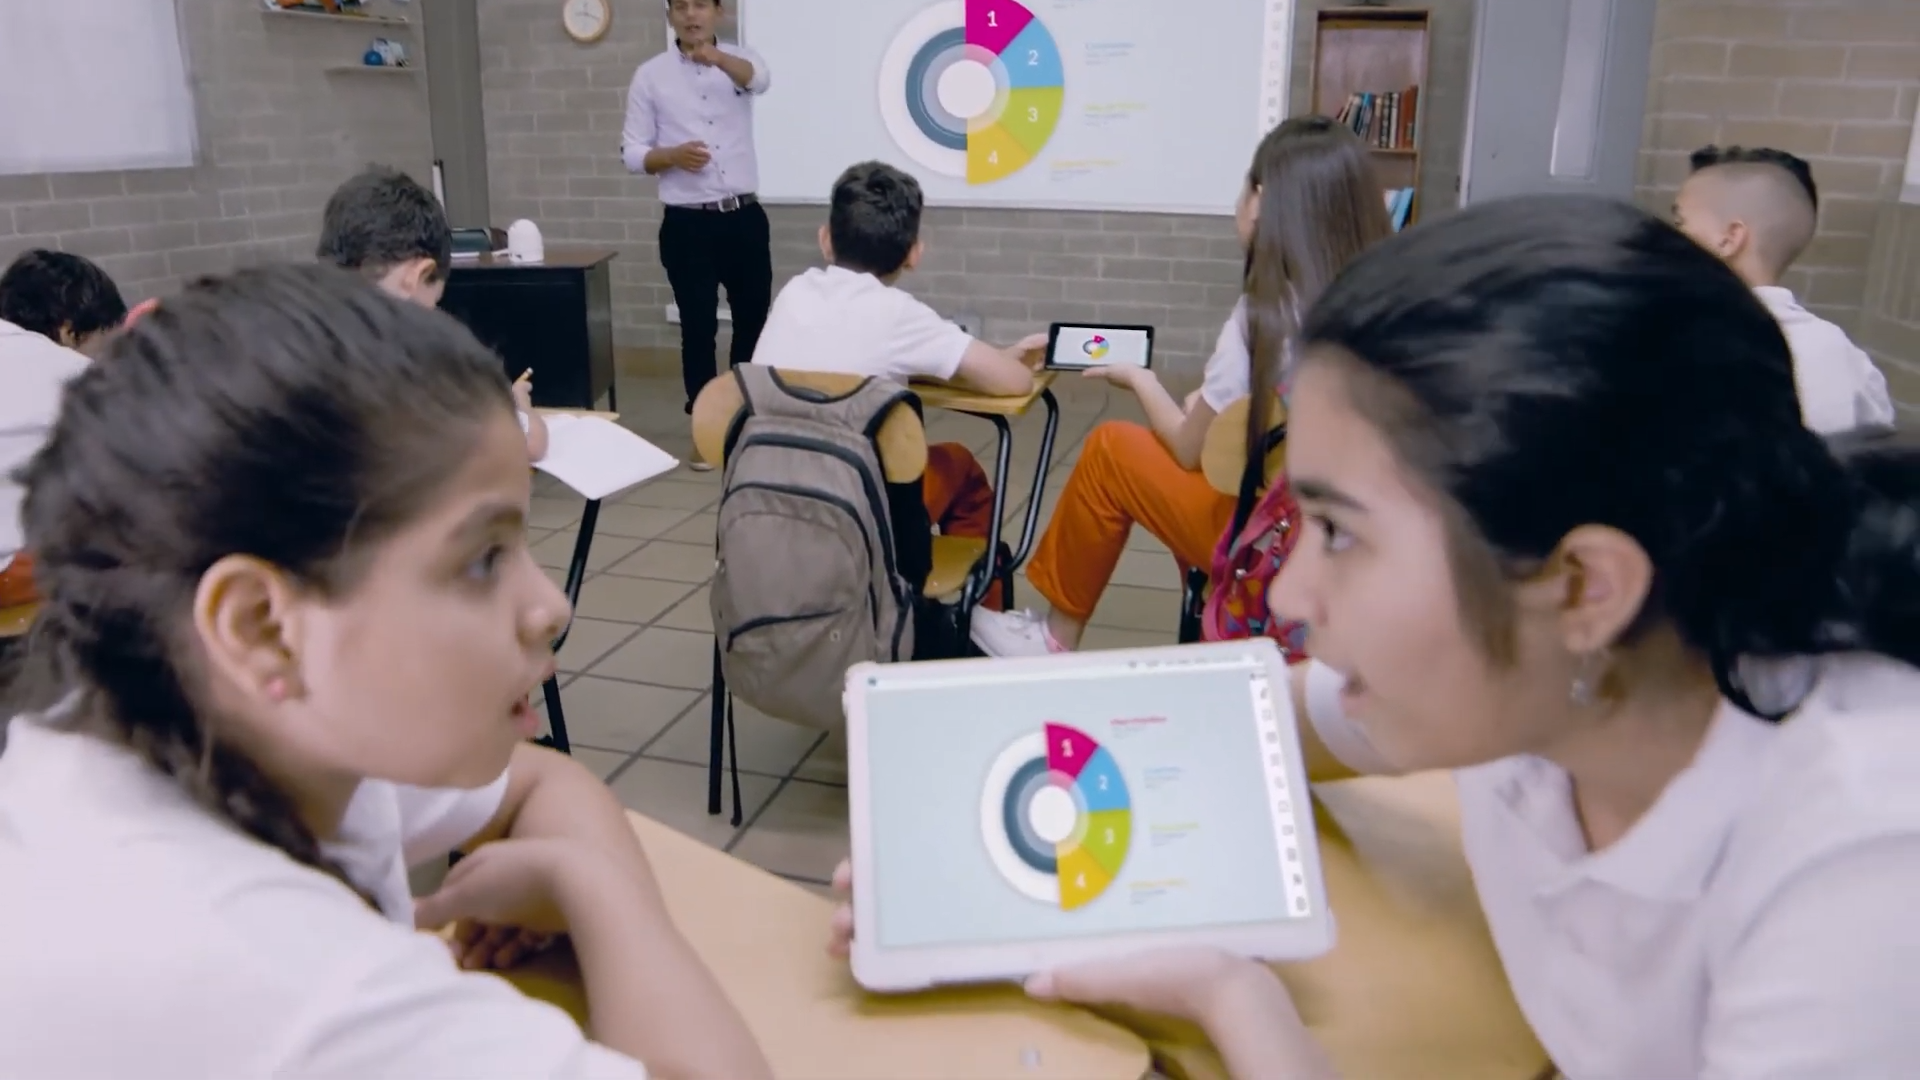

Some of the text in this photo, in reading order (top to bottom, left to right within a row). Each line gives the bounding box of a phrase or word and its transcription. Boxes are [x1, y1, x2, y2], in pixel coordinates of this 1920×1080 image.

[987, 10, 998, 27] 1
[1027, 49, 1039, 66] 2
[1027, 106, 1039, 123] 3
[987, 149, 999, 165] 4
[1061, 738, 1074, 757] 1
[1098, 774, 1109, 791] 2
[1074, 872, 1087, 889] 4
